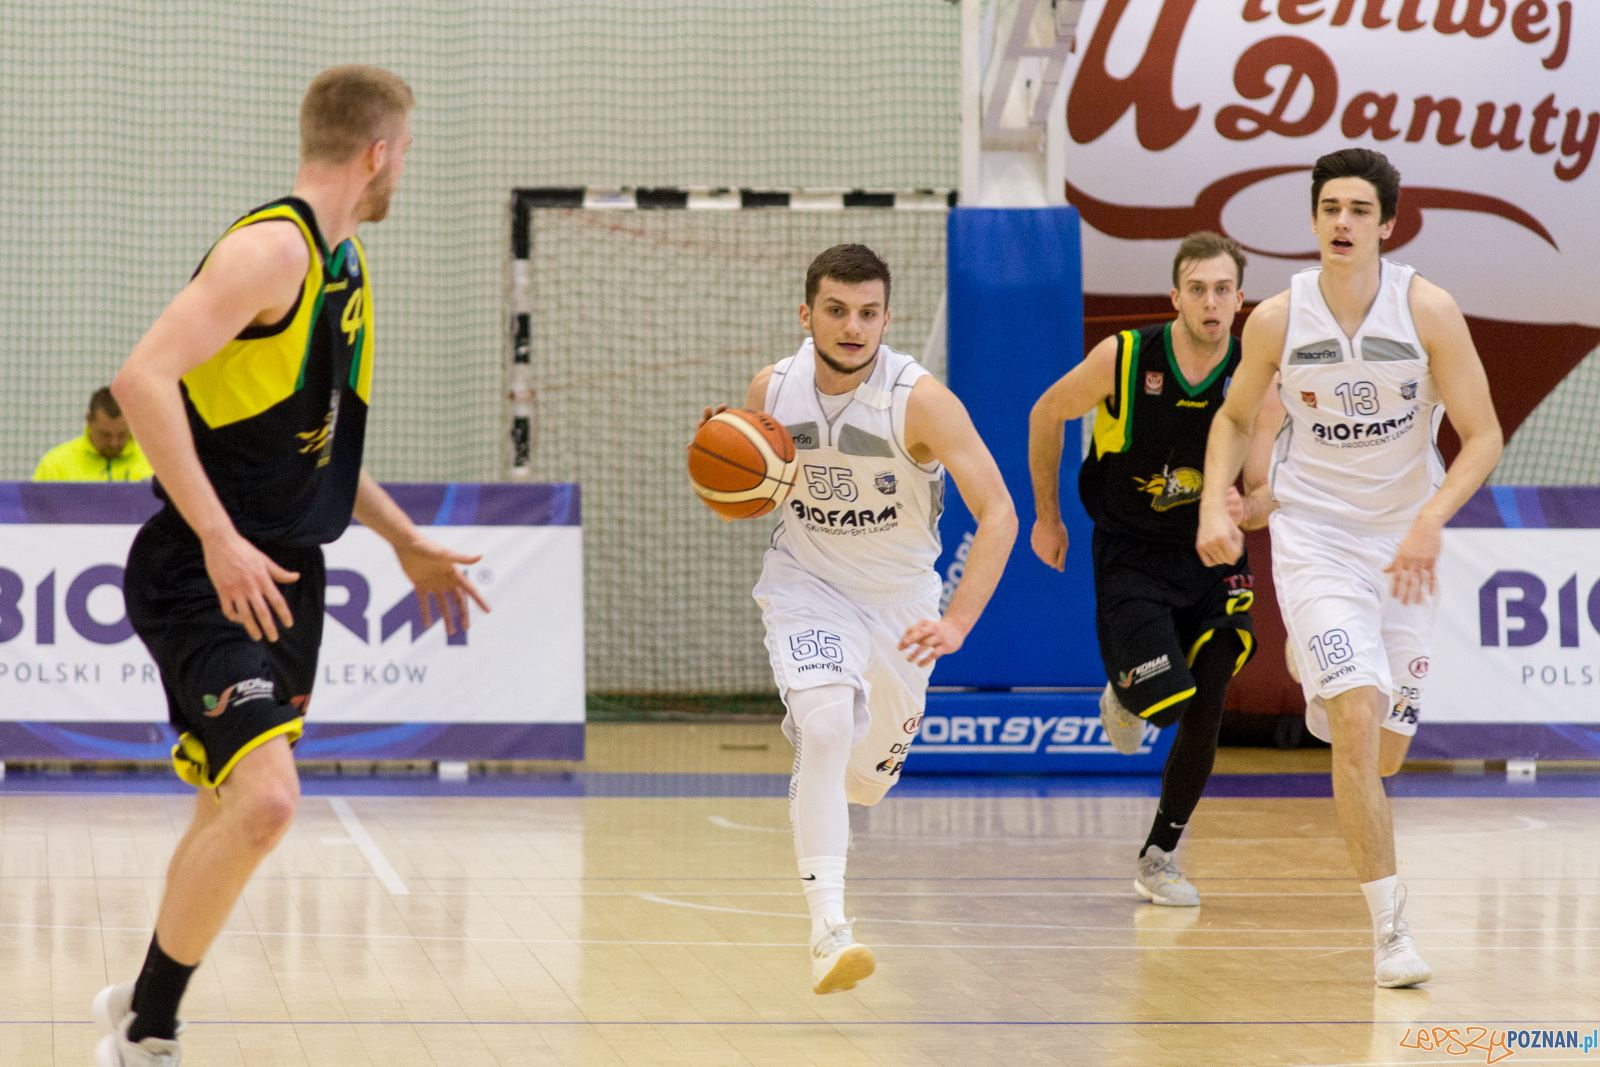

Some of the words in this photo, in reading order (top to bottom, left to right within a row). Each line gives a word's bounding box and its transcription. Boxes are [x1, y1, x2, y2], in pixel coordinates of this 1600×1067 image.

[1241, 0, 1573, 71] eniwej
[1214, 35, 1600, 181] Danuty
[1334, 380, 1380, 417] 13
[803, 464, 858, 503] 55
[788, 629, 844, 664] 55
[1308, 628, 1354, 672] 13
[324, 658, 428, 685] LEKÓW
[797, 661, 842, 674] macron
[1521, 664, 1600, 685] POLS
